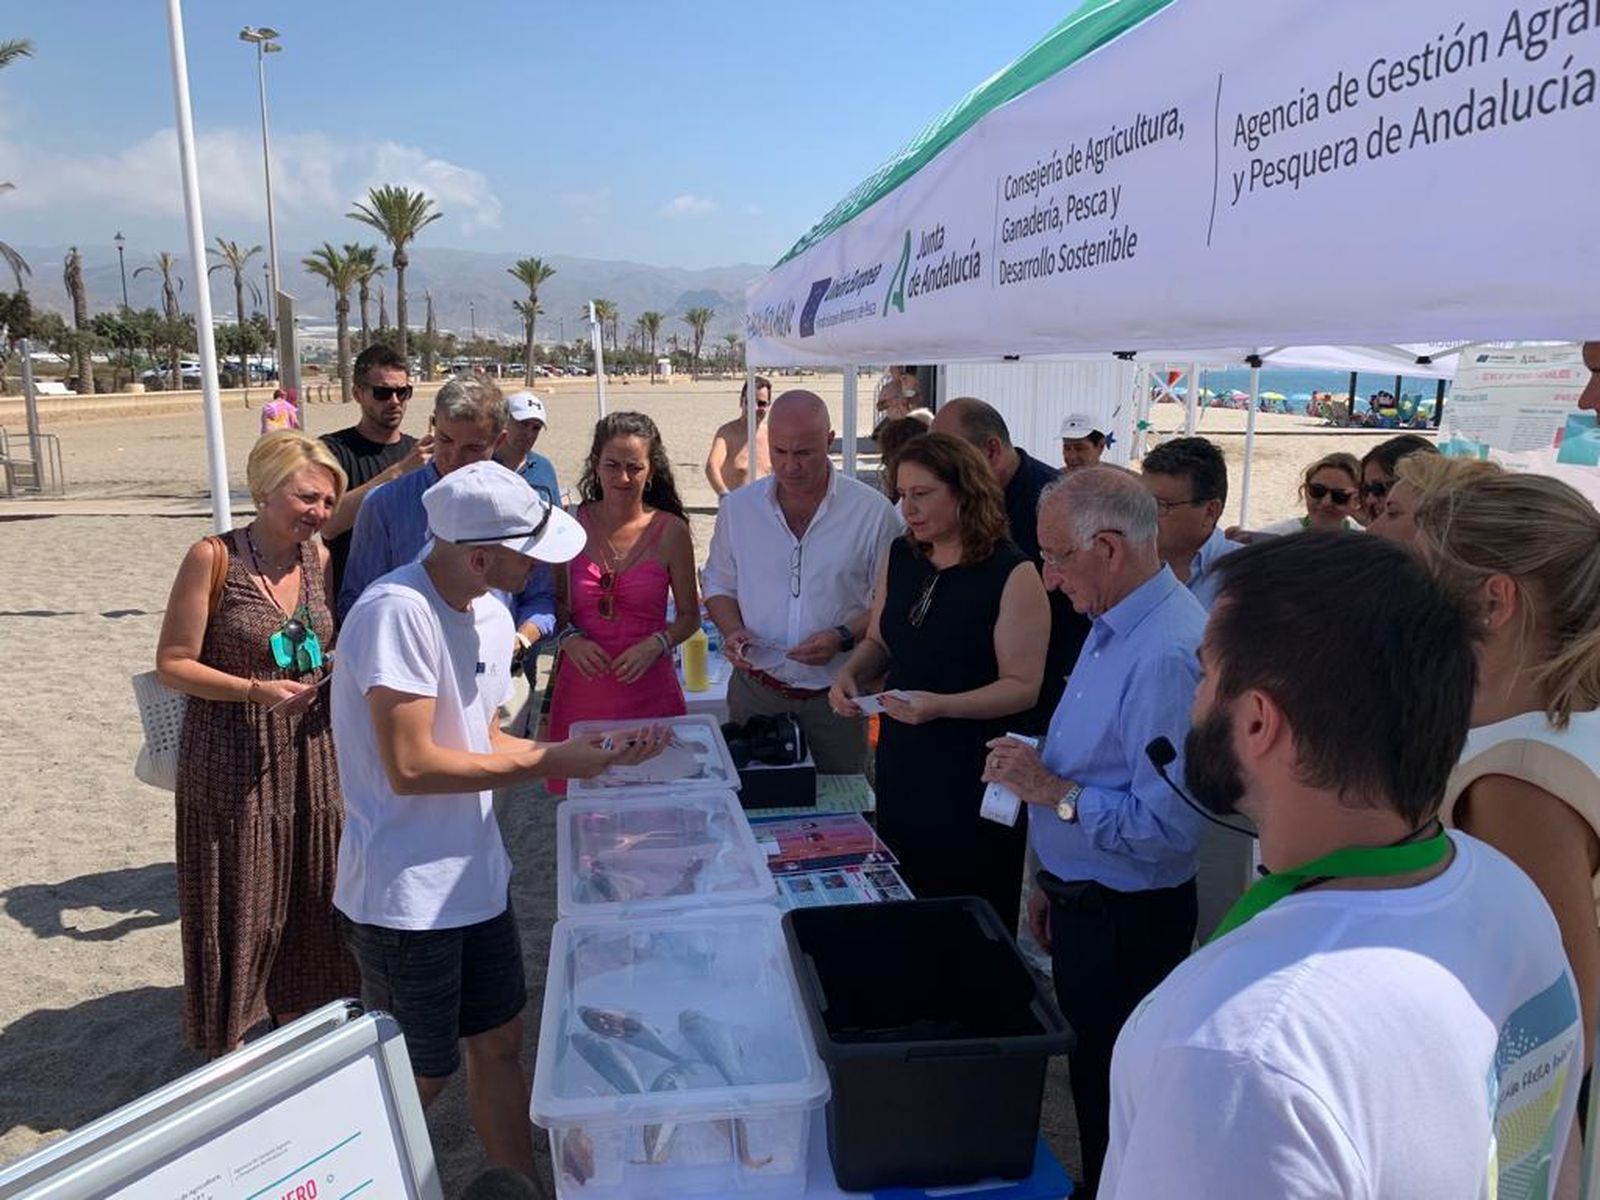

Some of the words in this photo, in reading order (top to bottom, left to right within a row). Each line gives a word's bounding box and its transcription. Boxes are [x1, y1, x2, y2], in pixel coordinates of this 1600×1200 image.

[1233, 87, 1319, 152] Agencia
[1326, 71, 1359, 114] de
[1367, 22, 1488, 99] Gestión
[1004, 150, 1063, 201] Consejería
[1065, 143, 1083, 178] de
[1085, 106, 1184, 174] Agricultura,
[1231, 170, 1246, 206] y
[1249, 135, 1358, 190] Pesquera
[1366, 116, 1401, 159] de
[1409, 54, 1596, 149] Andalucía
[916, 222, 945, 260] Junta
[1002, 197, 1063, 244] Ganadería,
[1066, 189, 1108, 224] Pesca
[1110, 184, 1122, 220] y
[907, 268, 921, 298] de
[920, 238, 981, 294] Andalucía
[999, 246, 1055, 286] Desarrollo
[1057, 225, 1138, 273] Sostenible
